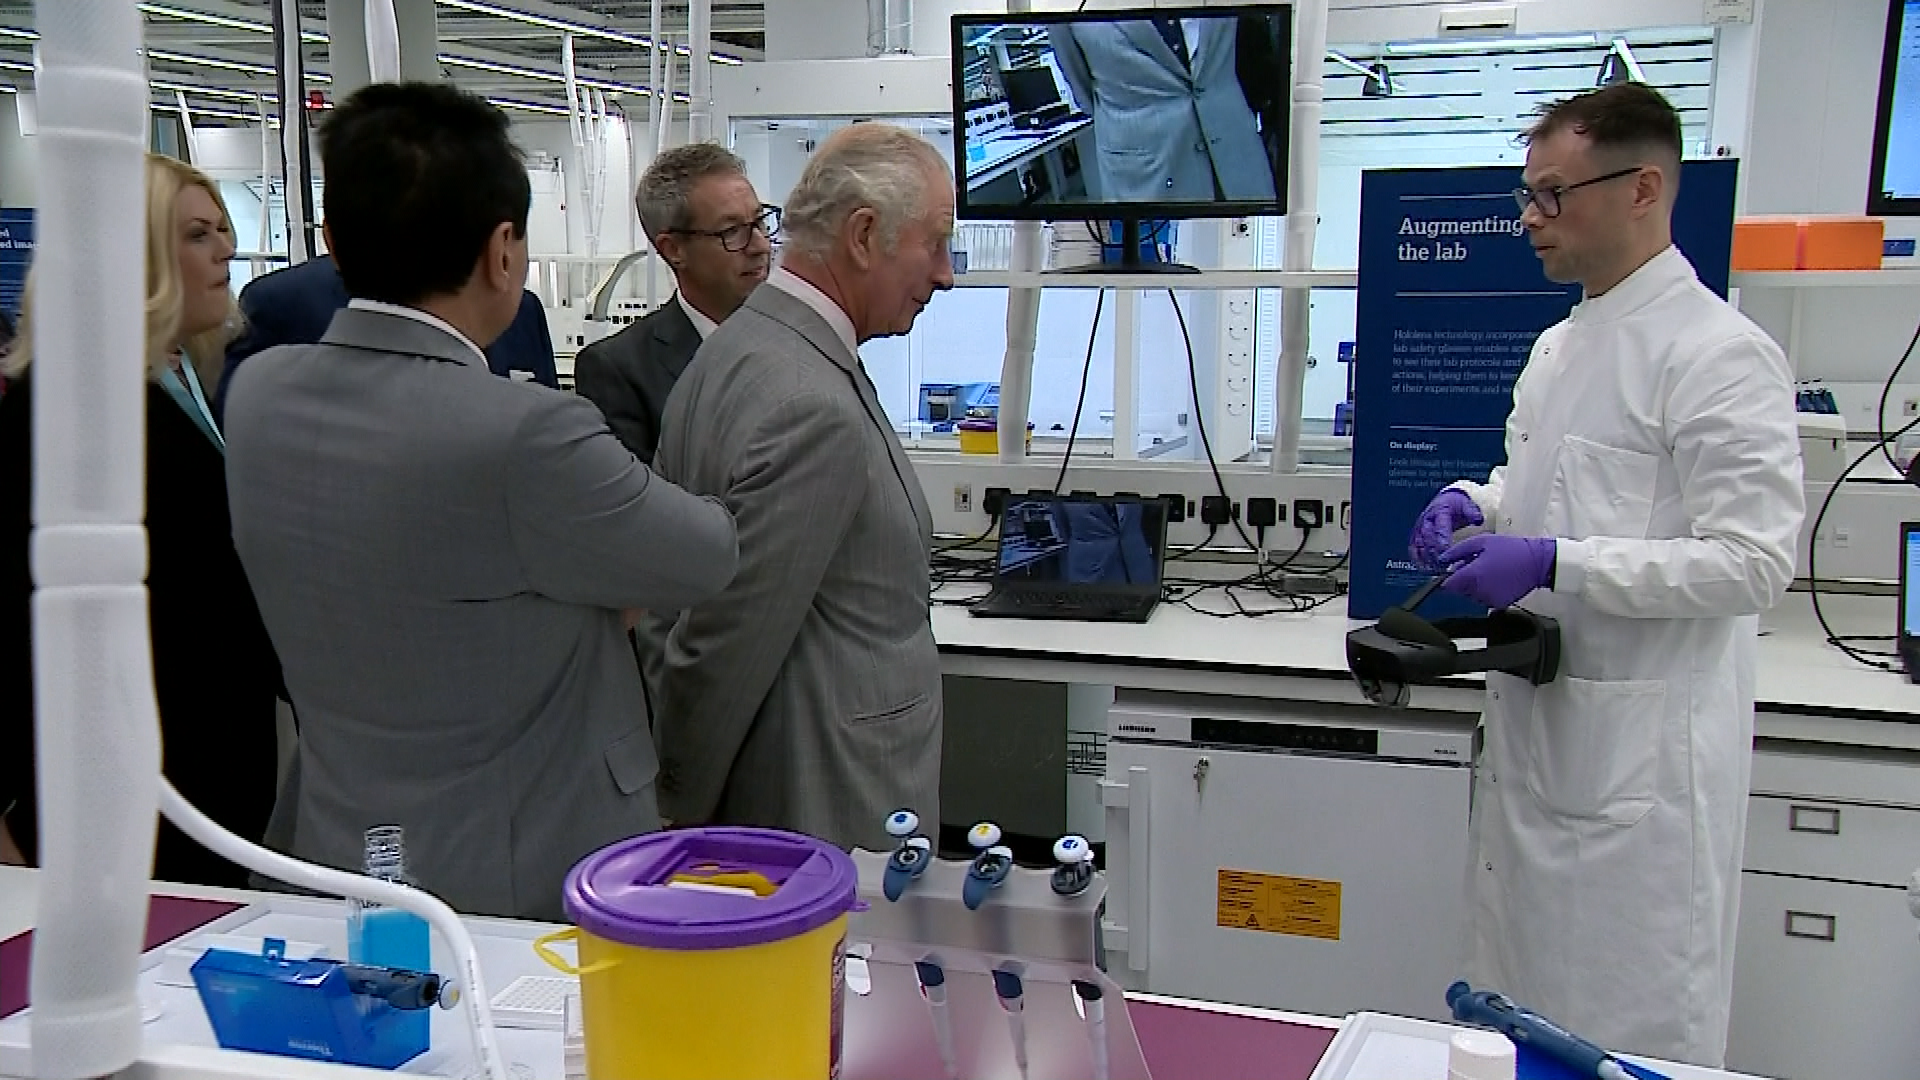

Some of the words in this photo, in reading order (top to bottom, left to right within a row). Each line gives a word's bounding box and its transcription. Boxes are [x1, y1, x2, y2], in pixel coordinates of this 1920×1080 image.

[1398, 216, 1524, 239] Augmenting
[1397, 241, 1430, 261] the
[1435, 241, 1468, 261] lab
[1434, 329, 1484, 341] technology
[1485, 331, 1540, 341] incorporate
[1393, 343, 1408, 353] lab
[1410, 344, 1435, 355] safety
[1438, 343, 1473, 354] glasses
[1473, 344, 1509, 353] enables
[1392, 358, 1402, 367] to
[1403, 359, 1419, 367] see
[1420, 357, 1441, 367] their
[1443, 357, 1458, 367] lab
[1460, 358, 1501, 369] protocols
[1502, 358, 1522, 367] and
[1428, 371, 1461, 381] helping
[1463, 371, 1487, 381] them
[1488, 371, 1499, 381] to
[1391, 384, 1400, 393] of
[1402, 383, 1424, 393] their
[1425, 385, 1480, 394] experiments
[1481, 384, 1500, 394] and
[1389, 441, 1403, 451] On
[1404, 441, 1438, 452] display:
